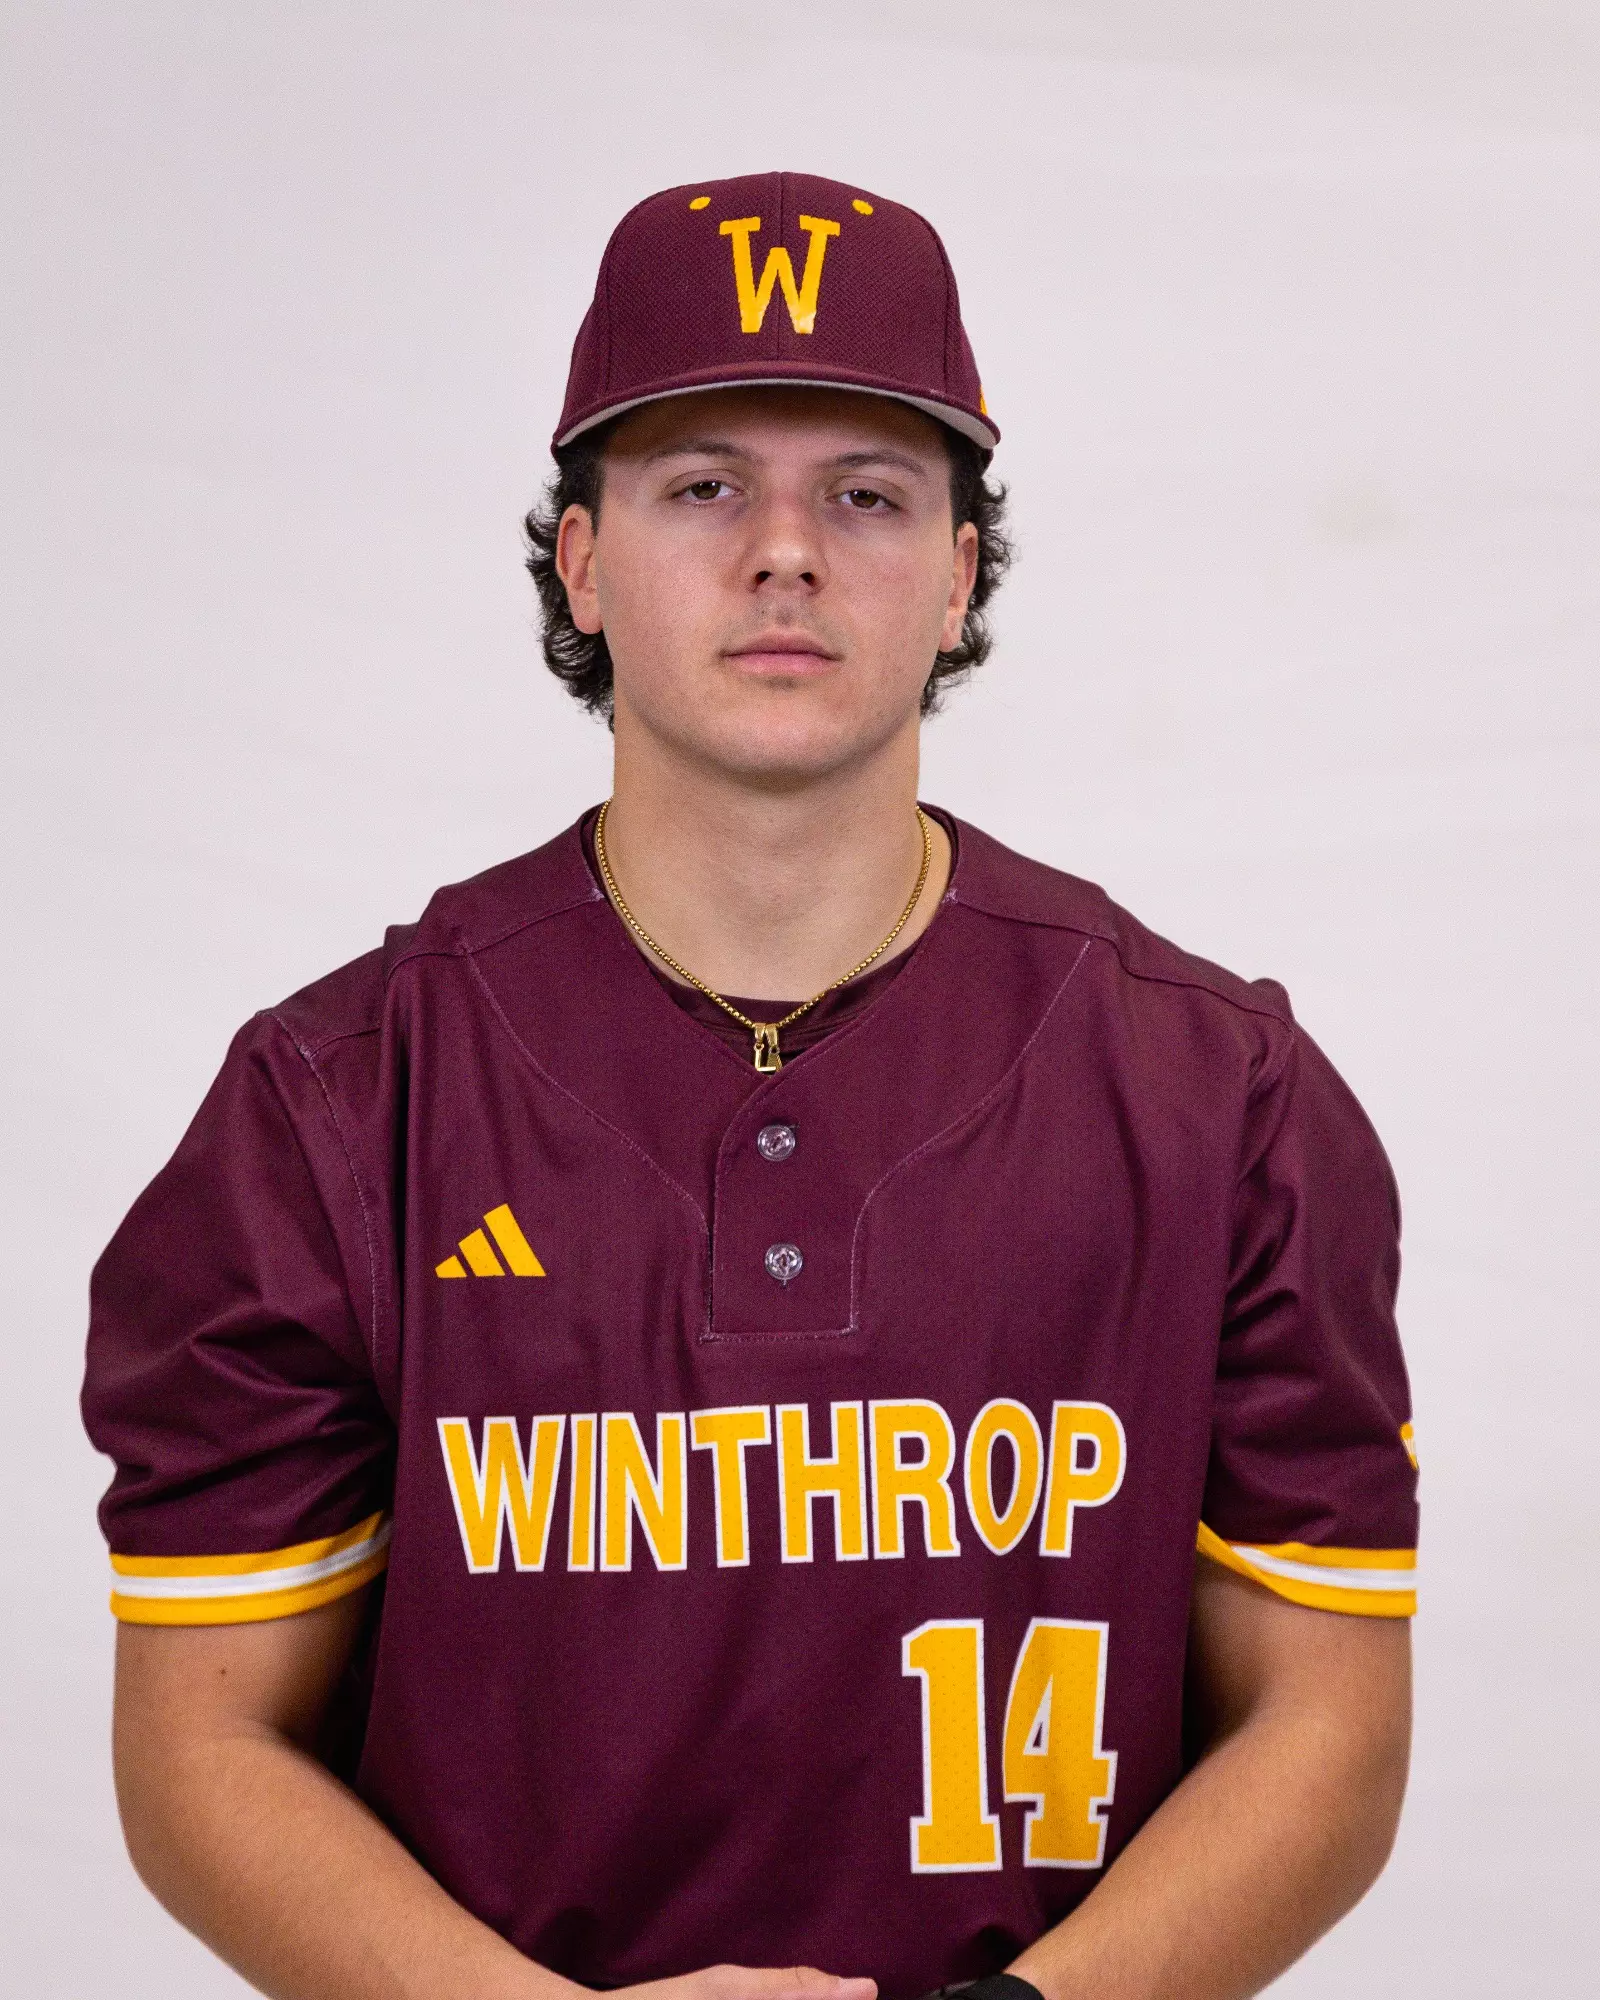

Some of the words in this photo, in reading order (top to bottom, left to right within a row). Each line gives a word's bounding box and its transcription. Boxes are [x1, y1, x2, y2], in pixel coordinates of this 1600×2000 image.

[719, 216, 841, 334] W
[437, 1398, 1127, 1574] WINTHROP
[901, 1617, 1118, 1874] 14
